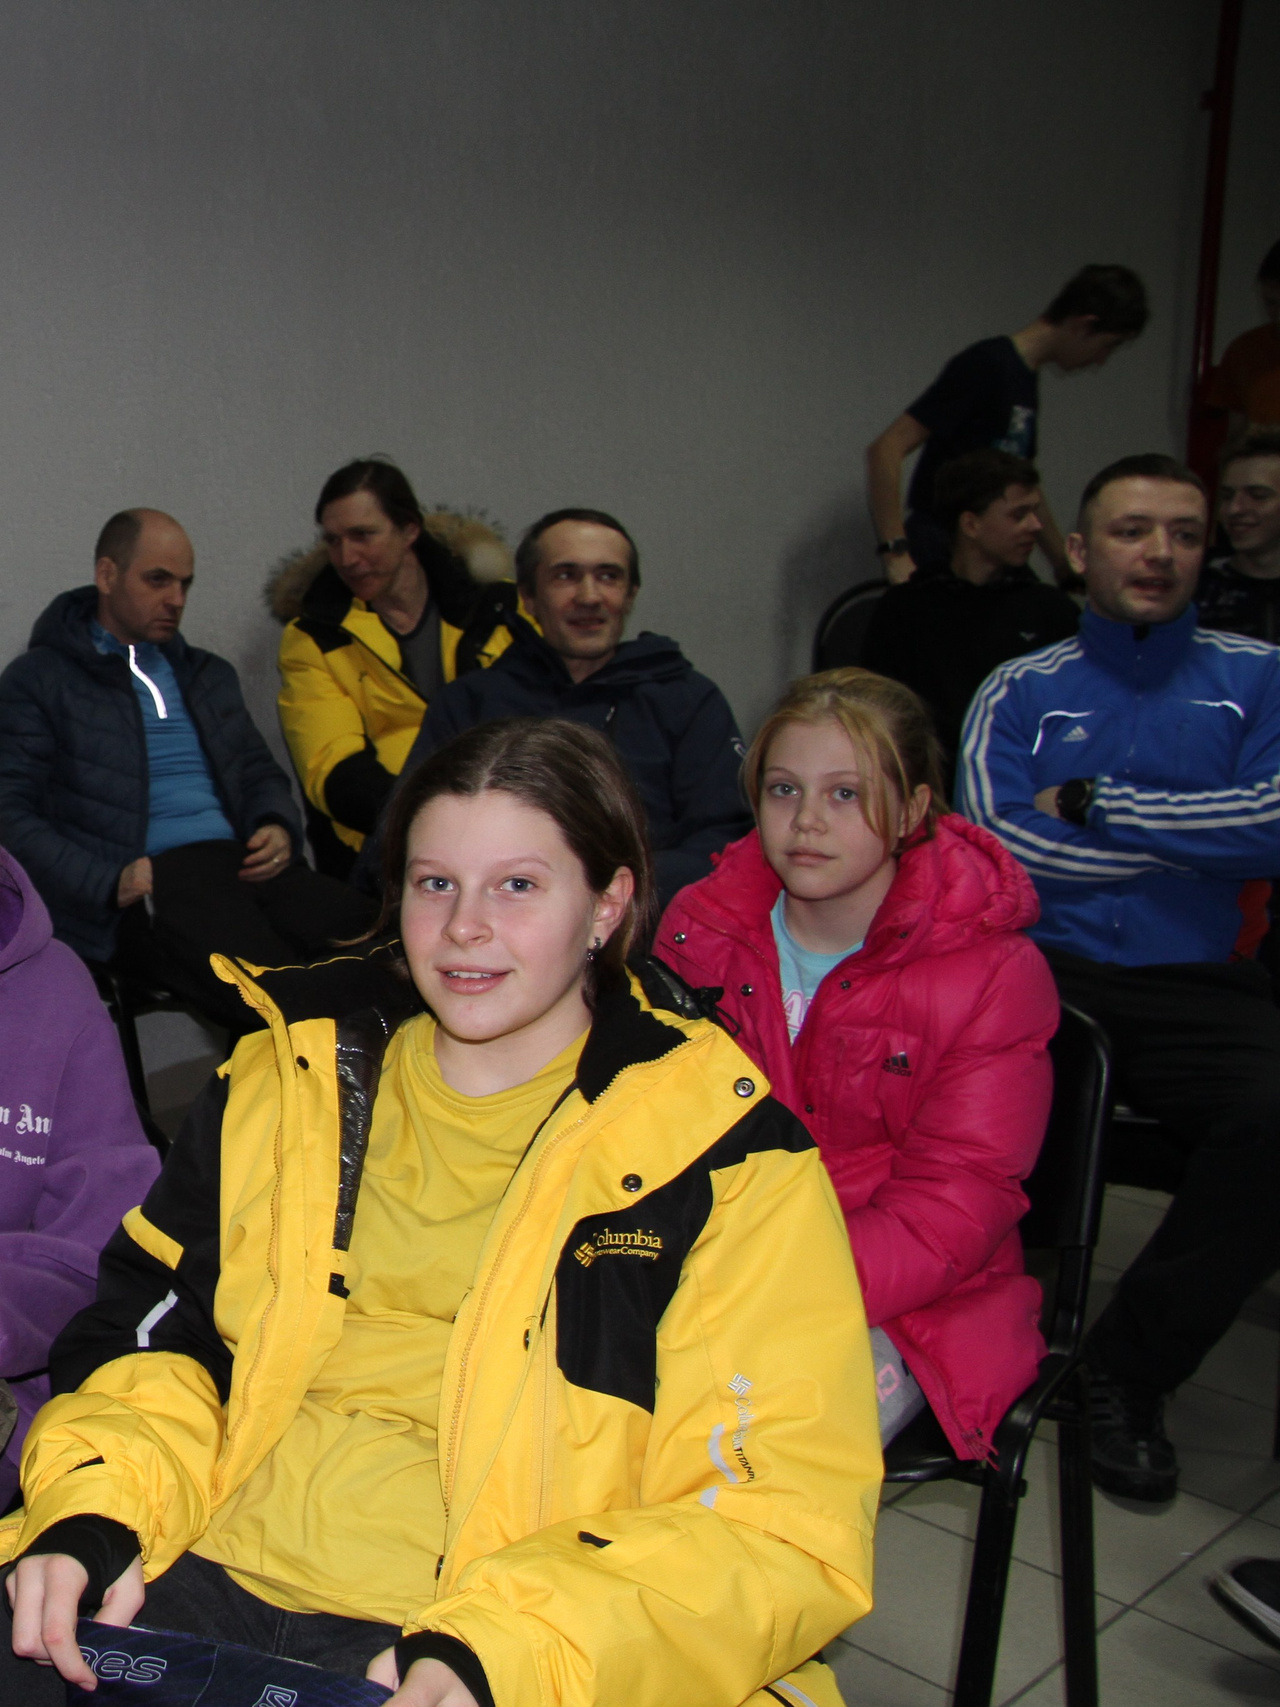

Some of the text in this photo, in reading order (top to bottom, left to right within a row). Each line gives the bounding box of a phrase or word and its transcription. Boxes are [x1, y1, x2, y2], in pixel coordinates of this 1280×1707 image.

[15, 1103, 53, 1137] An
[14, 1150, 46, 1166] Angels
[593, 1228, 663, 1249] olumbia
